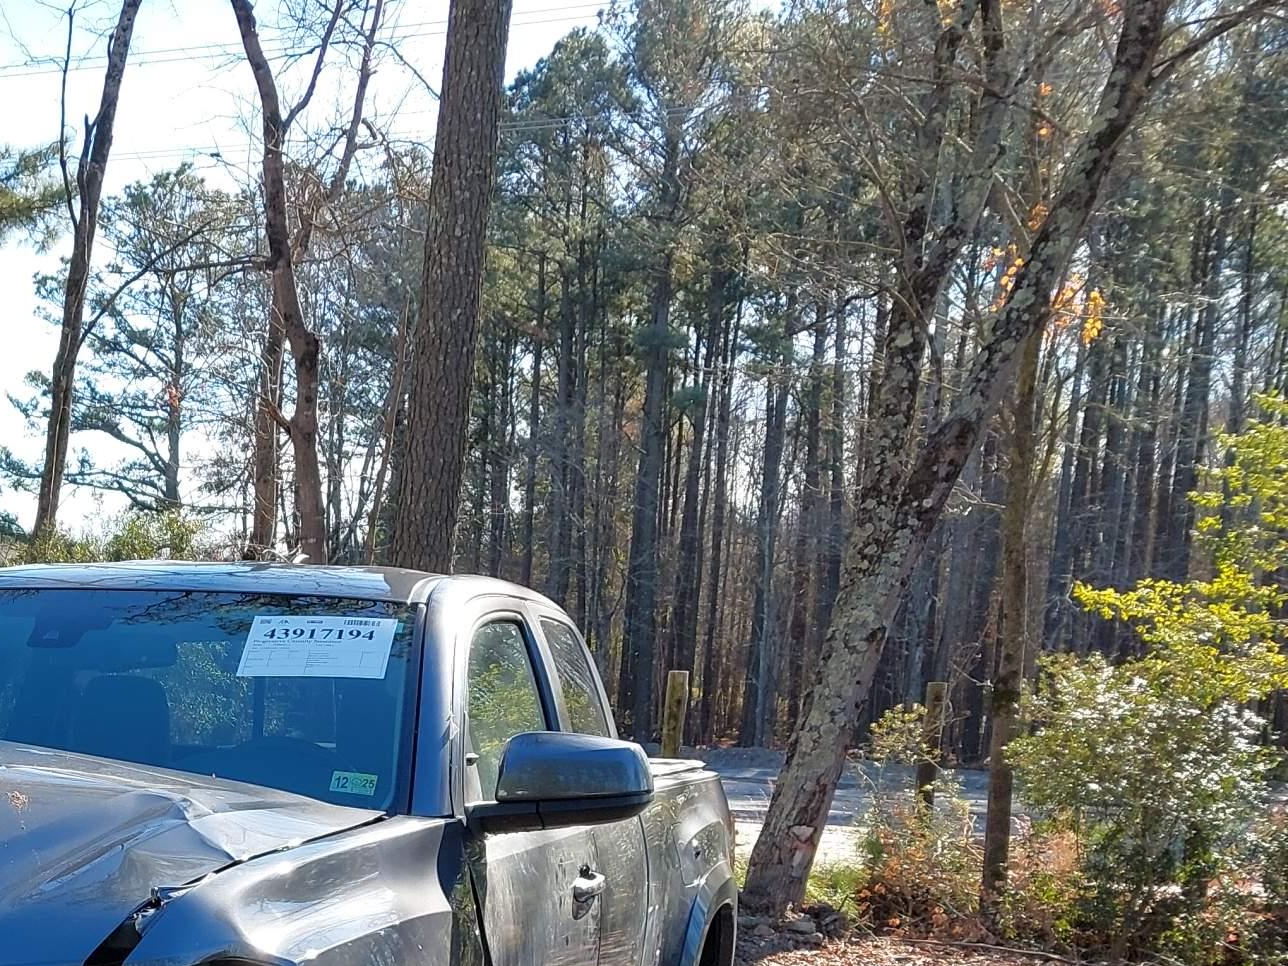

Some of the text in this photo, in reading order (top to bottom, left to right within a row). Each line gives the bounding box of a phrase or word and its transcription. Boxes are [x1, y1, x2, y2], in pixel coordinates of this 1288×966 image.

[264, 628, 375, 641] 43917194
[335, 776, 375, 789] 12 25
